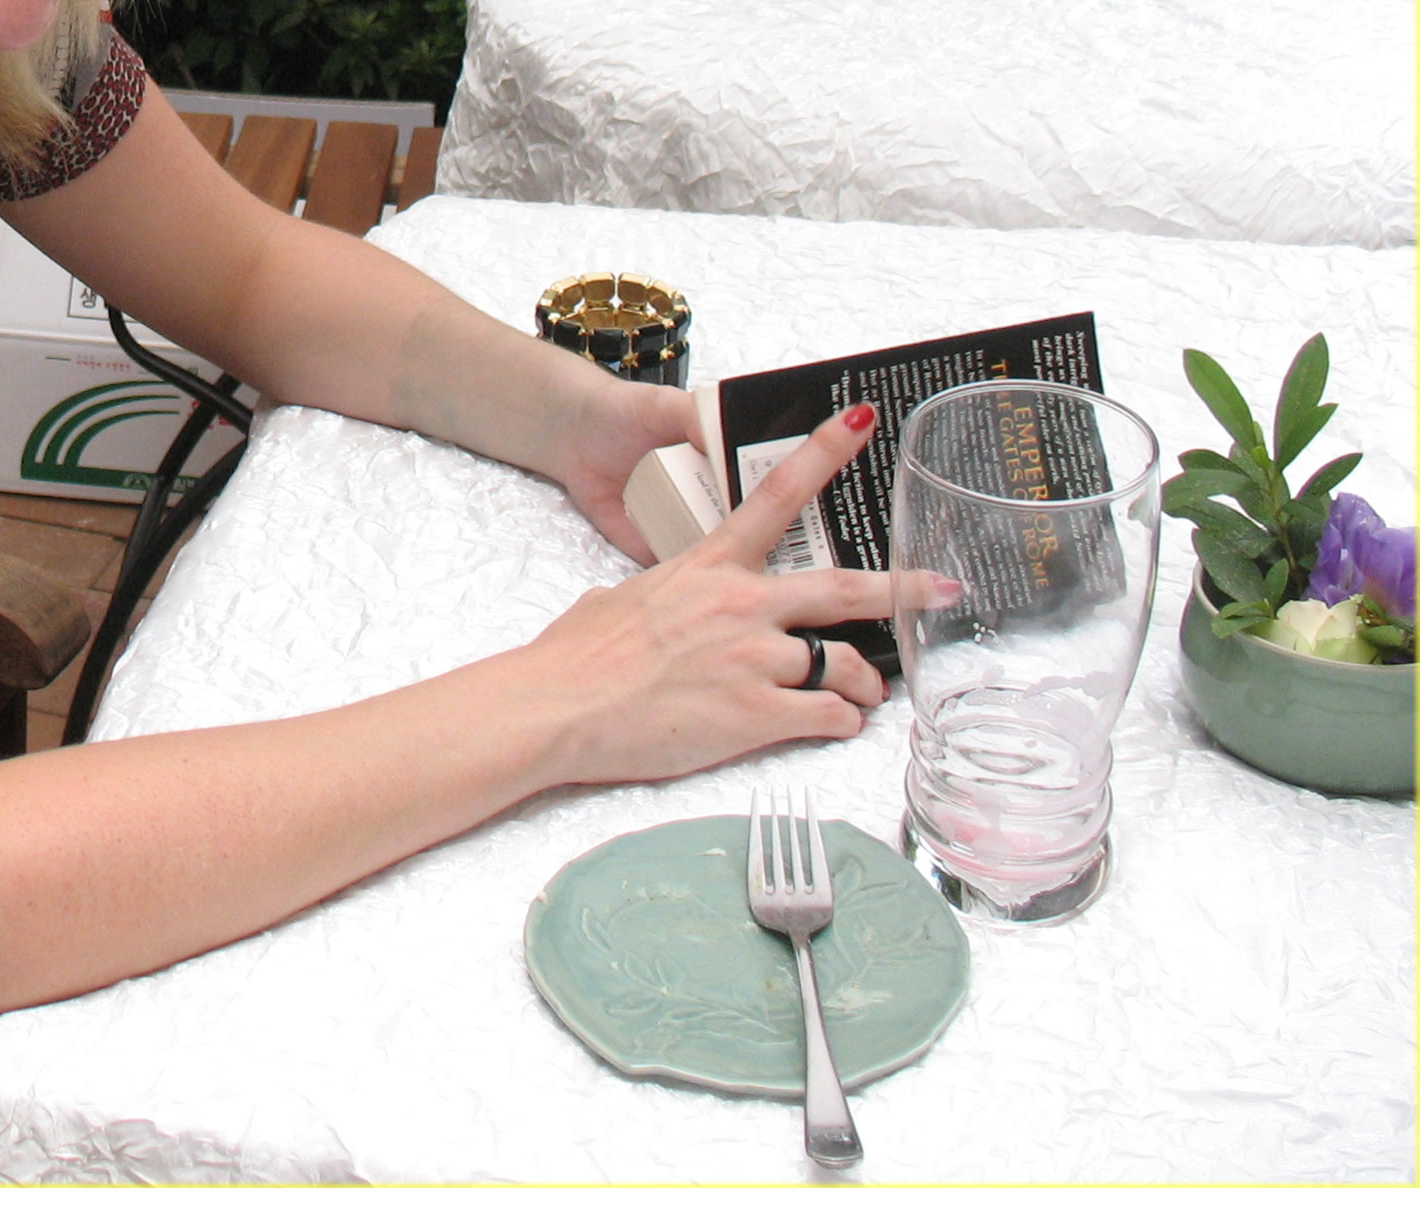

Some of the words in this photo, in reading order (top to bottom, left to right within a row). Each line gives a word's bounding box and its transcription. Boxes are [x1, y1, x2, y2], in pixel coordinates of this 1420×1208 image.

[1031, 339, 1041, 363] most
[1041, 336, 1050, 348] of
[1064, 332, 1073, 355] dark
[1044, 351, 1053, 367] the
[1053, 334, 1063, 366] brings
[1058, 368, 1065, 380] us
[1074, 329, 1089, 379] Sweeping
[858, 370, 867, 388] and
[867, 368, 877, 386] But
[878, 367, 886, 378] an
[889, 365, 900, 397] Roman
[910, 360, 922, 402] campaig
[829, 383, 840, 401] like
[871, 388, 878, 397] as
[879, 379, 896, 438] extraordinary
[876, 429, 886, 438] is
[866, 435, 879, 477] riendship
[877, 439, 890, 467] thrust
[852, 471, 865, 502] fiction
[873, 478, 884, 496] will
[883, 468, 894, 488] into
[1013, 405, 1060, 558] EMPEROR
[842, 482, 859, 524] Iggulden
[859, 504, 868, 514] to
[877, 497, 886, 509] be
[998, 415, 1024, 482] GATES
[1020, 527, 1049, 589] ROME
[837, 513, 851, 542] Today
[862, 516, 873, 538] keep
[878, 510, 889, 525] put
[852, 526, 862, 535] is
[855, 544, 870, 570] gran
[868, 540, 882, 570] adults
